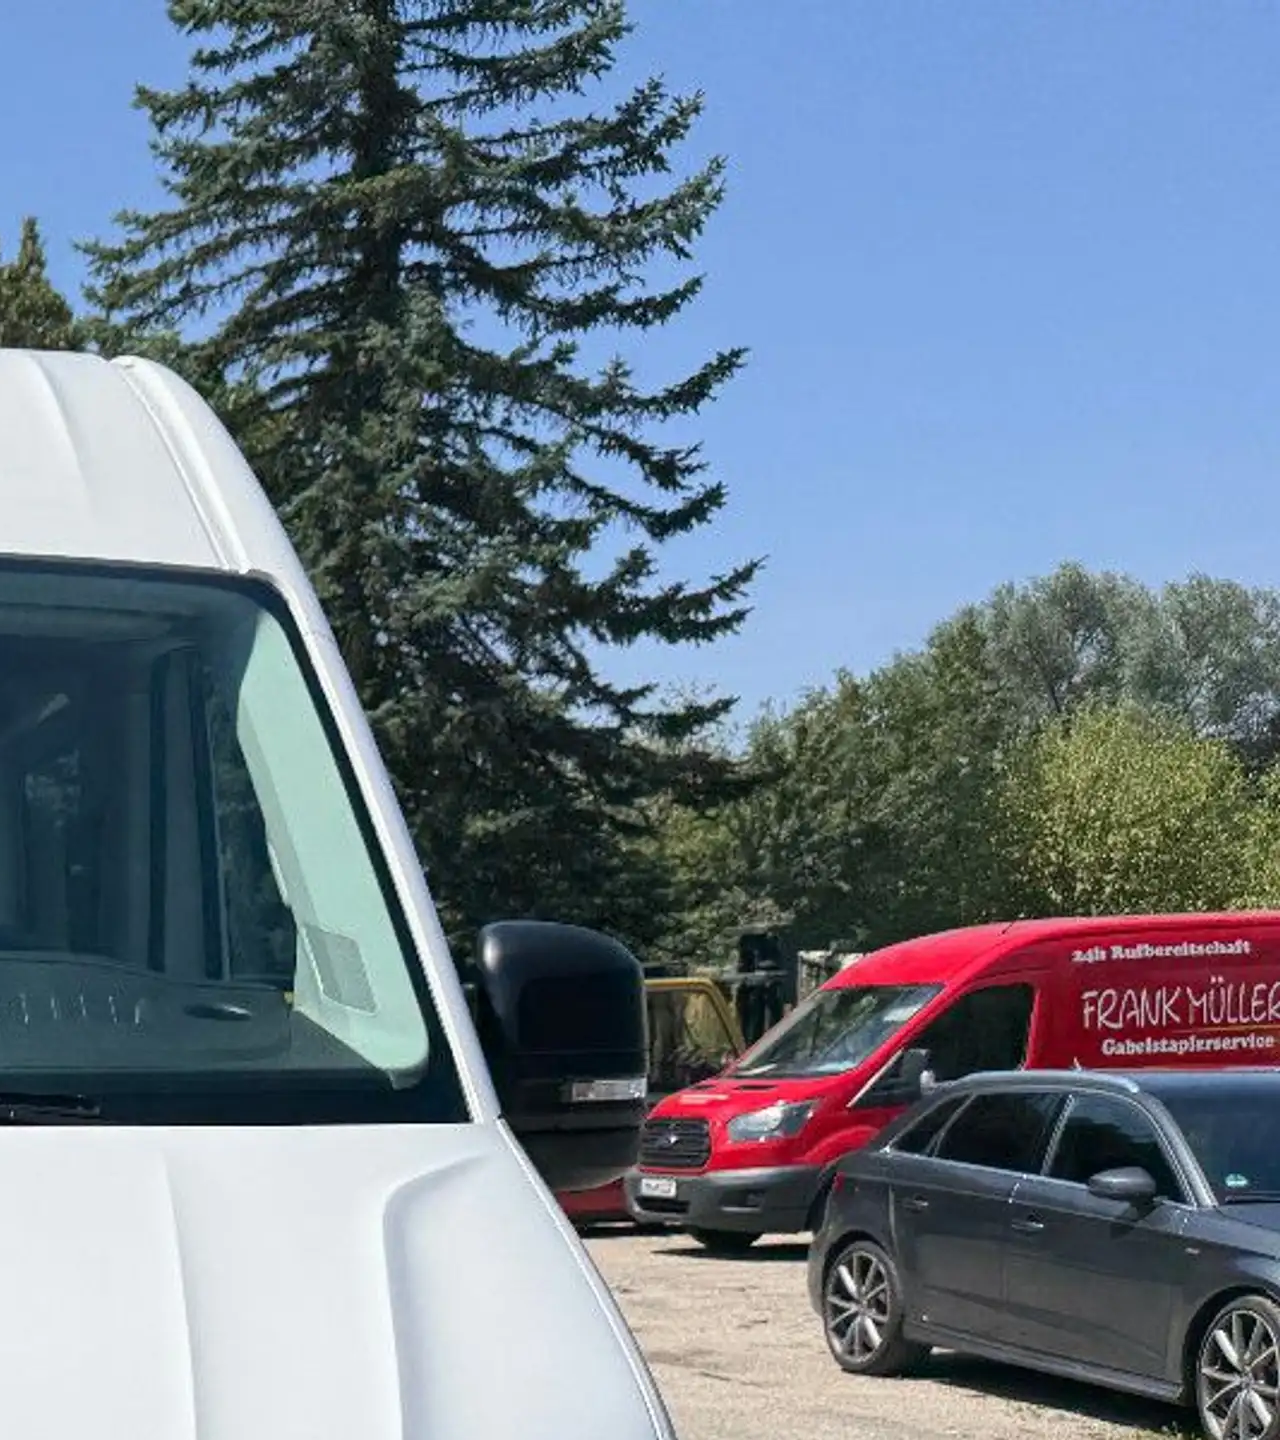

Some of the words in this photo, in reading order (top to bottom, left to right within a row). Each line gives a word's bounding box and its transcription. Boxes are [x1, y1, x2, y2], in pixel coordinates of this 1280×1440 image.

[1111, 938, 1251, 960] Rufbereitschaft
[1081, 986, 1181, 1030] FRANK
[1101, 1032, 1275, 1056] Gabelstaplerservice
